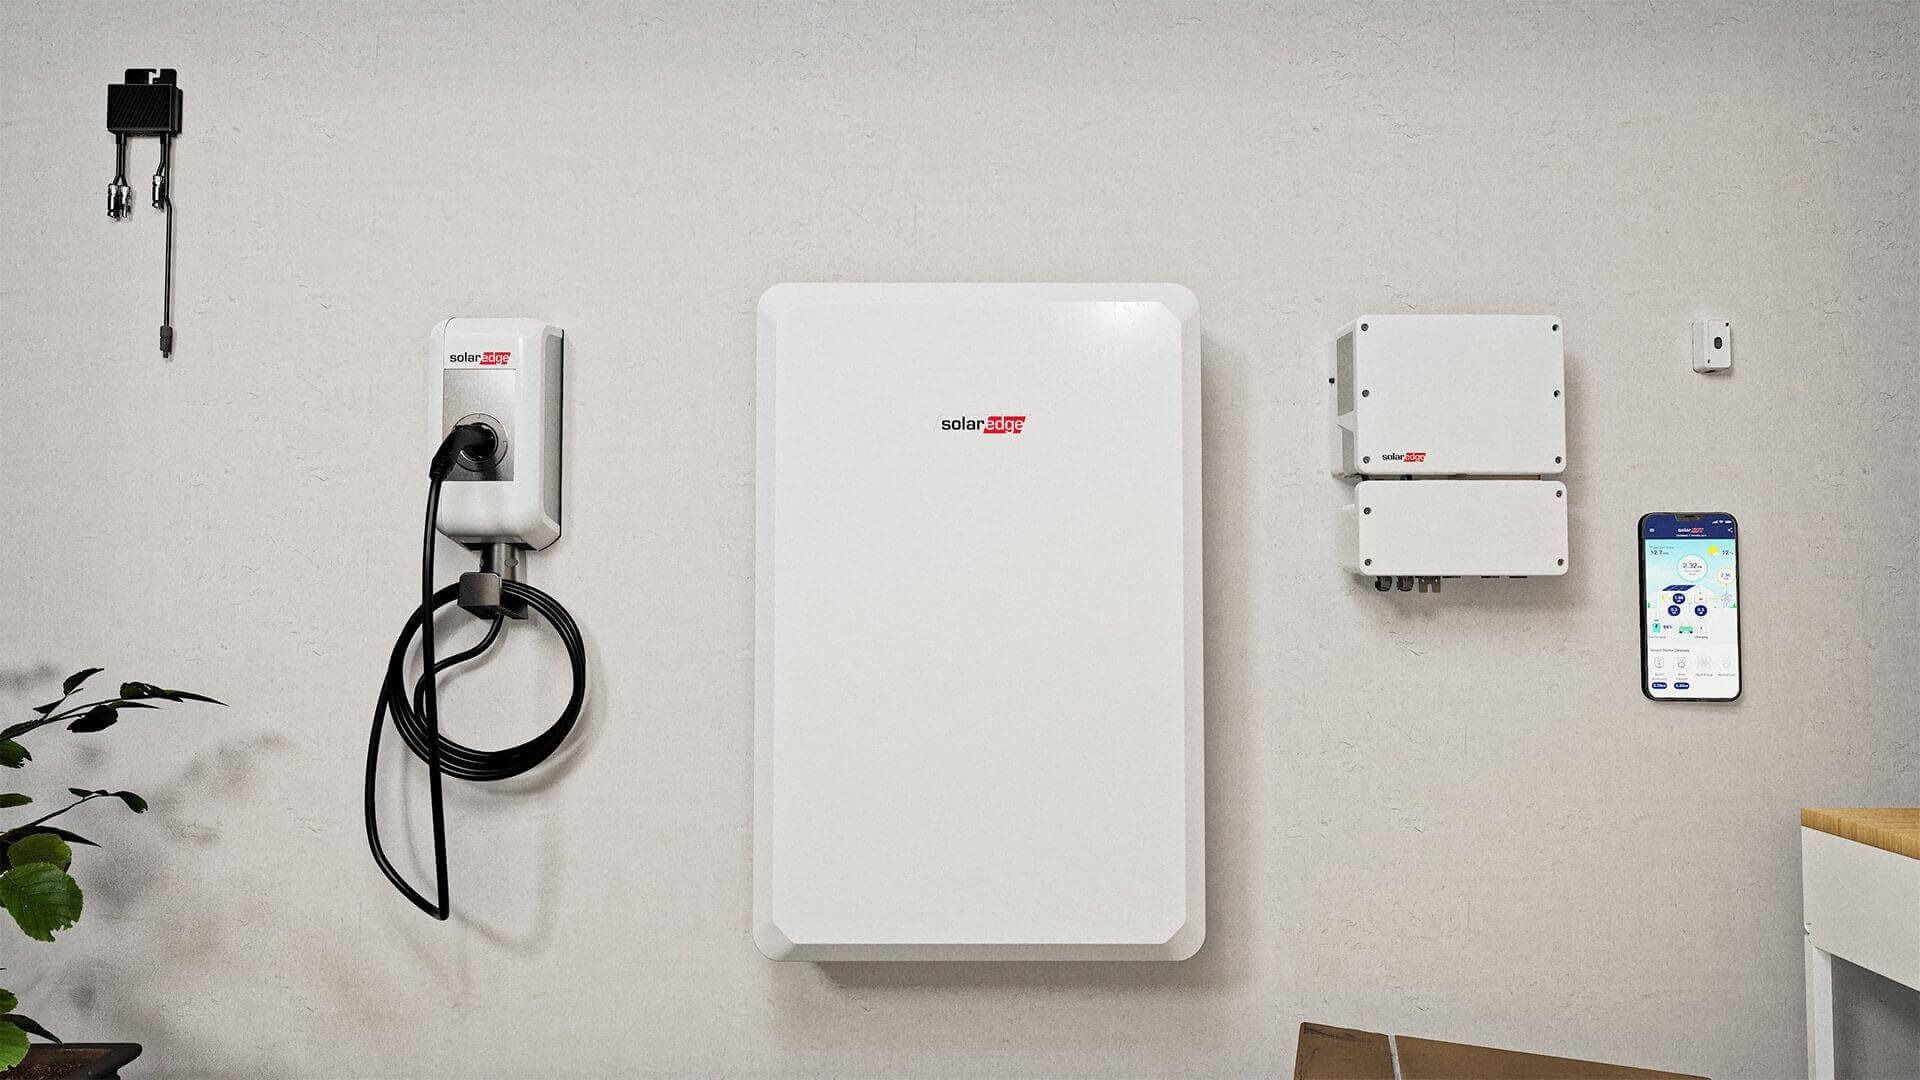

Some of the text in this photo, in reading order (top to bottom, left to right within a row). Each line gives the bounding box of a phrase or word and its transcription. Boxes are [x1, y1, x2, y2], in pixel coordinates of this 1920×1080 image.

[449, 352, 511, 365] solaredge
[941, 416, 1026, 434] solaredge
[1382, 452, 1426, 463] solaredge
